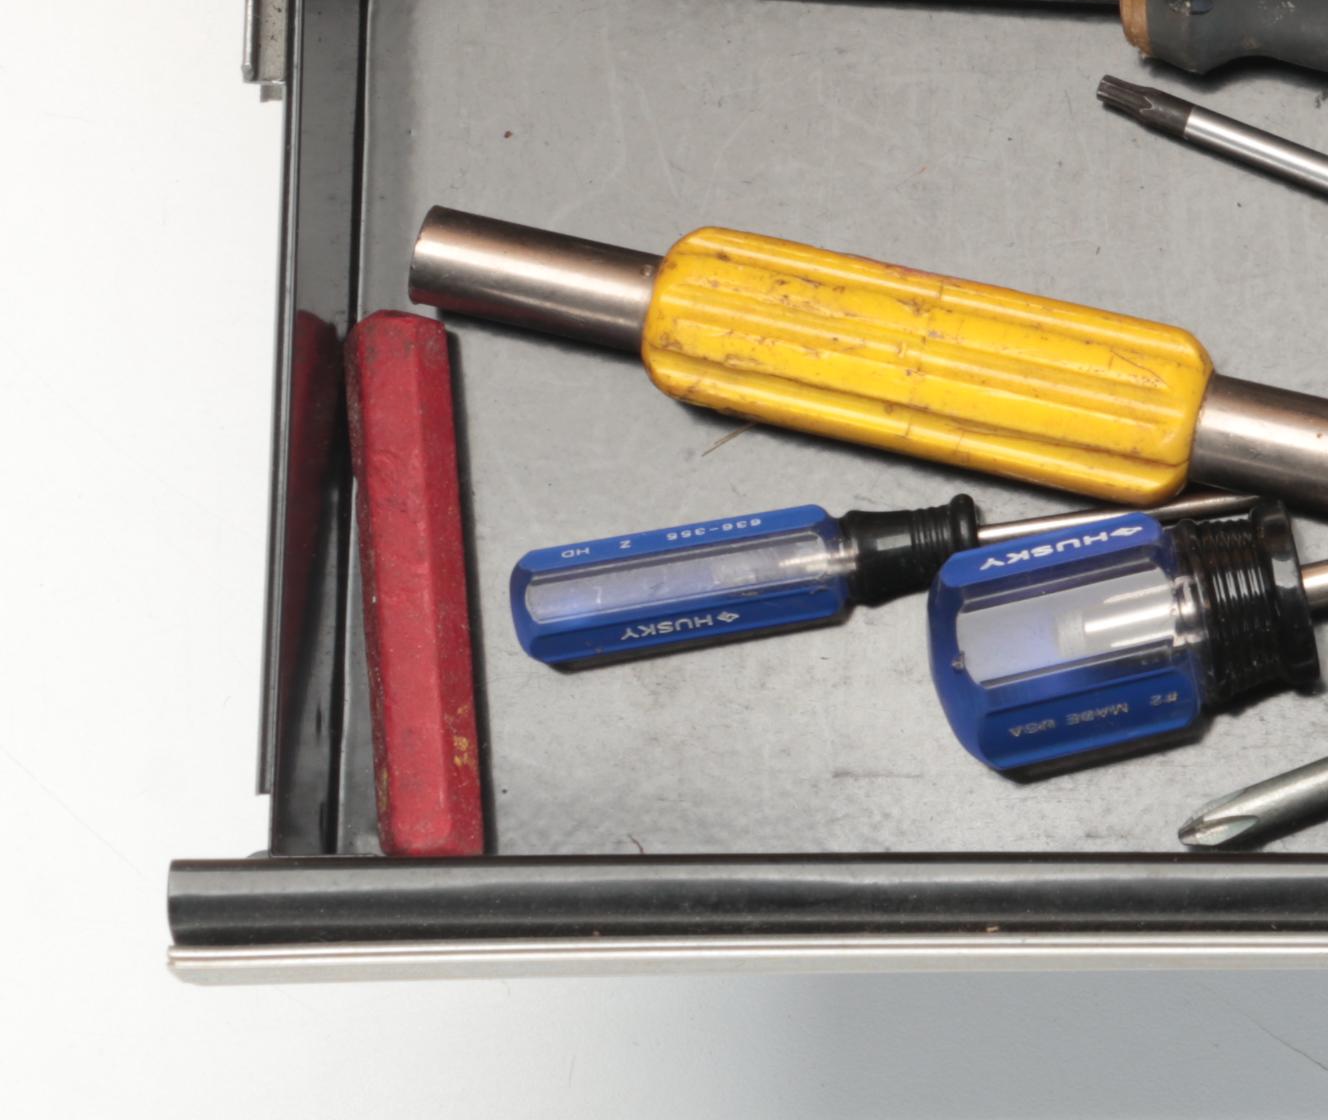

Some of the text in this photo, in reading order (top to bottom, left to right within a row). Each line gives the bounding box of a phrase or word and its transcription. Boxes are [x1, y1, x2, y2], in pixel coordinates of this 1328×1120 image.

[560, 546, 592, 559] HD
[980, 530, 1111, 571] HUSKY
[619, 613, 714, 641] HUSKY
[1007, 718, 1056, 737] USA
